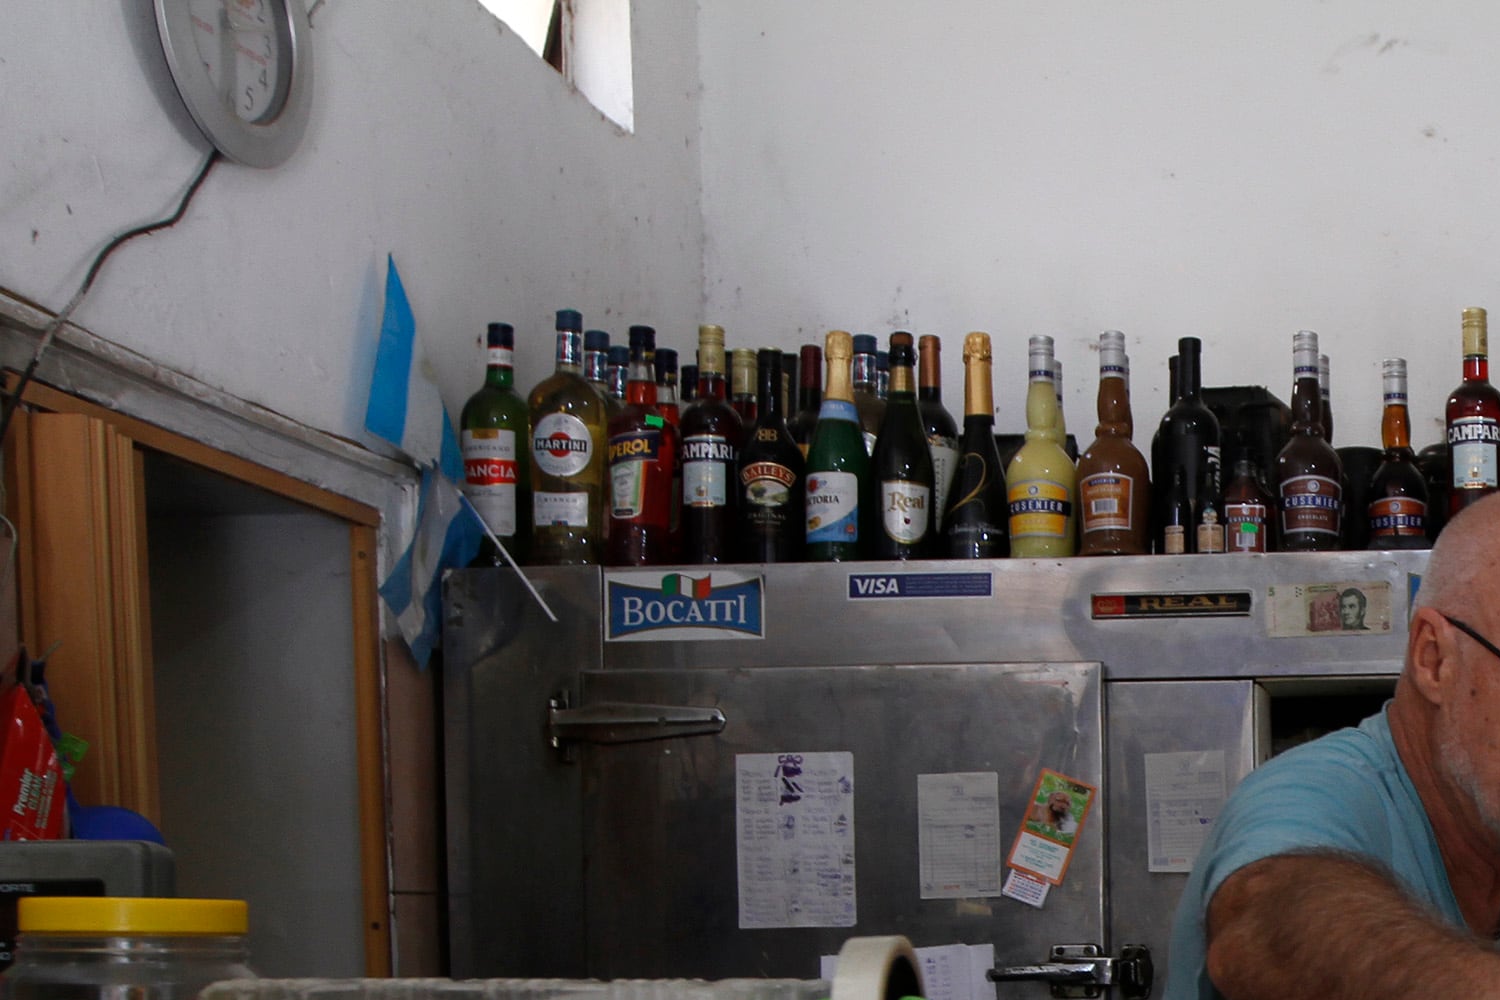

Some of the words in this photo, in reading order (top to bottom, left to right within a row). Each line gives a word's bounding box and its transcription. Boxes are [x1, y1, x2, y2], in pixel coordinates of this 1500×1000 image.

[535, 438, 587, 451] MARTINI
[609, 438, 652, 460] PEROL
[682, 443, 734, 460] AMPARI
[743, 464, 794, 480] BAILEYS
[887, 491, 925, 513] Real
[1285, 497, 1339, 510] CUSENIER
[854, 577, 900, 595] VISA
[623, 593, 747, 627] BOCATTI
